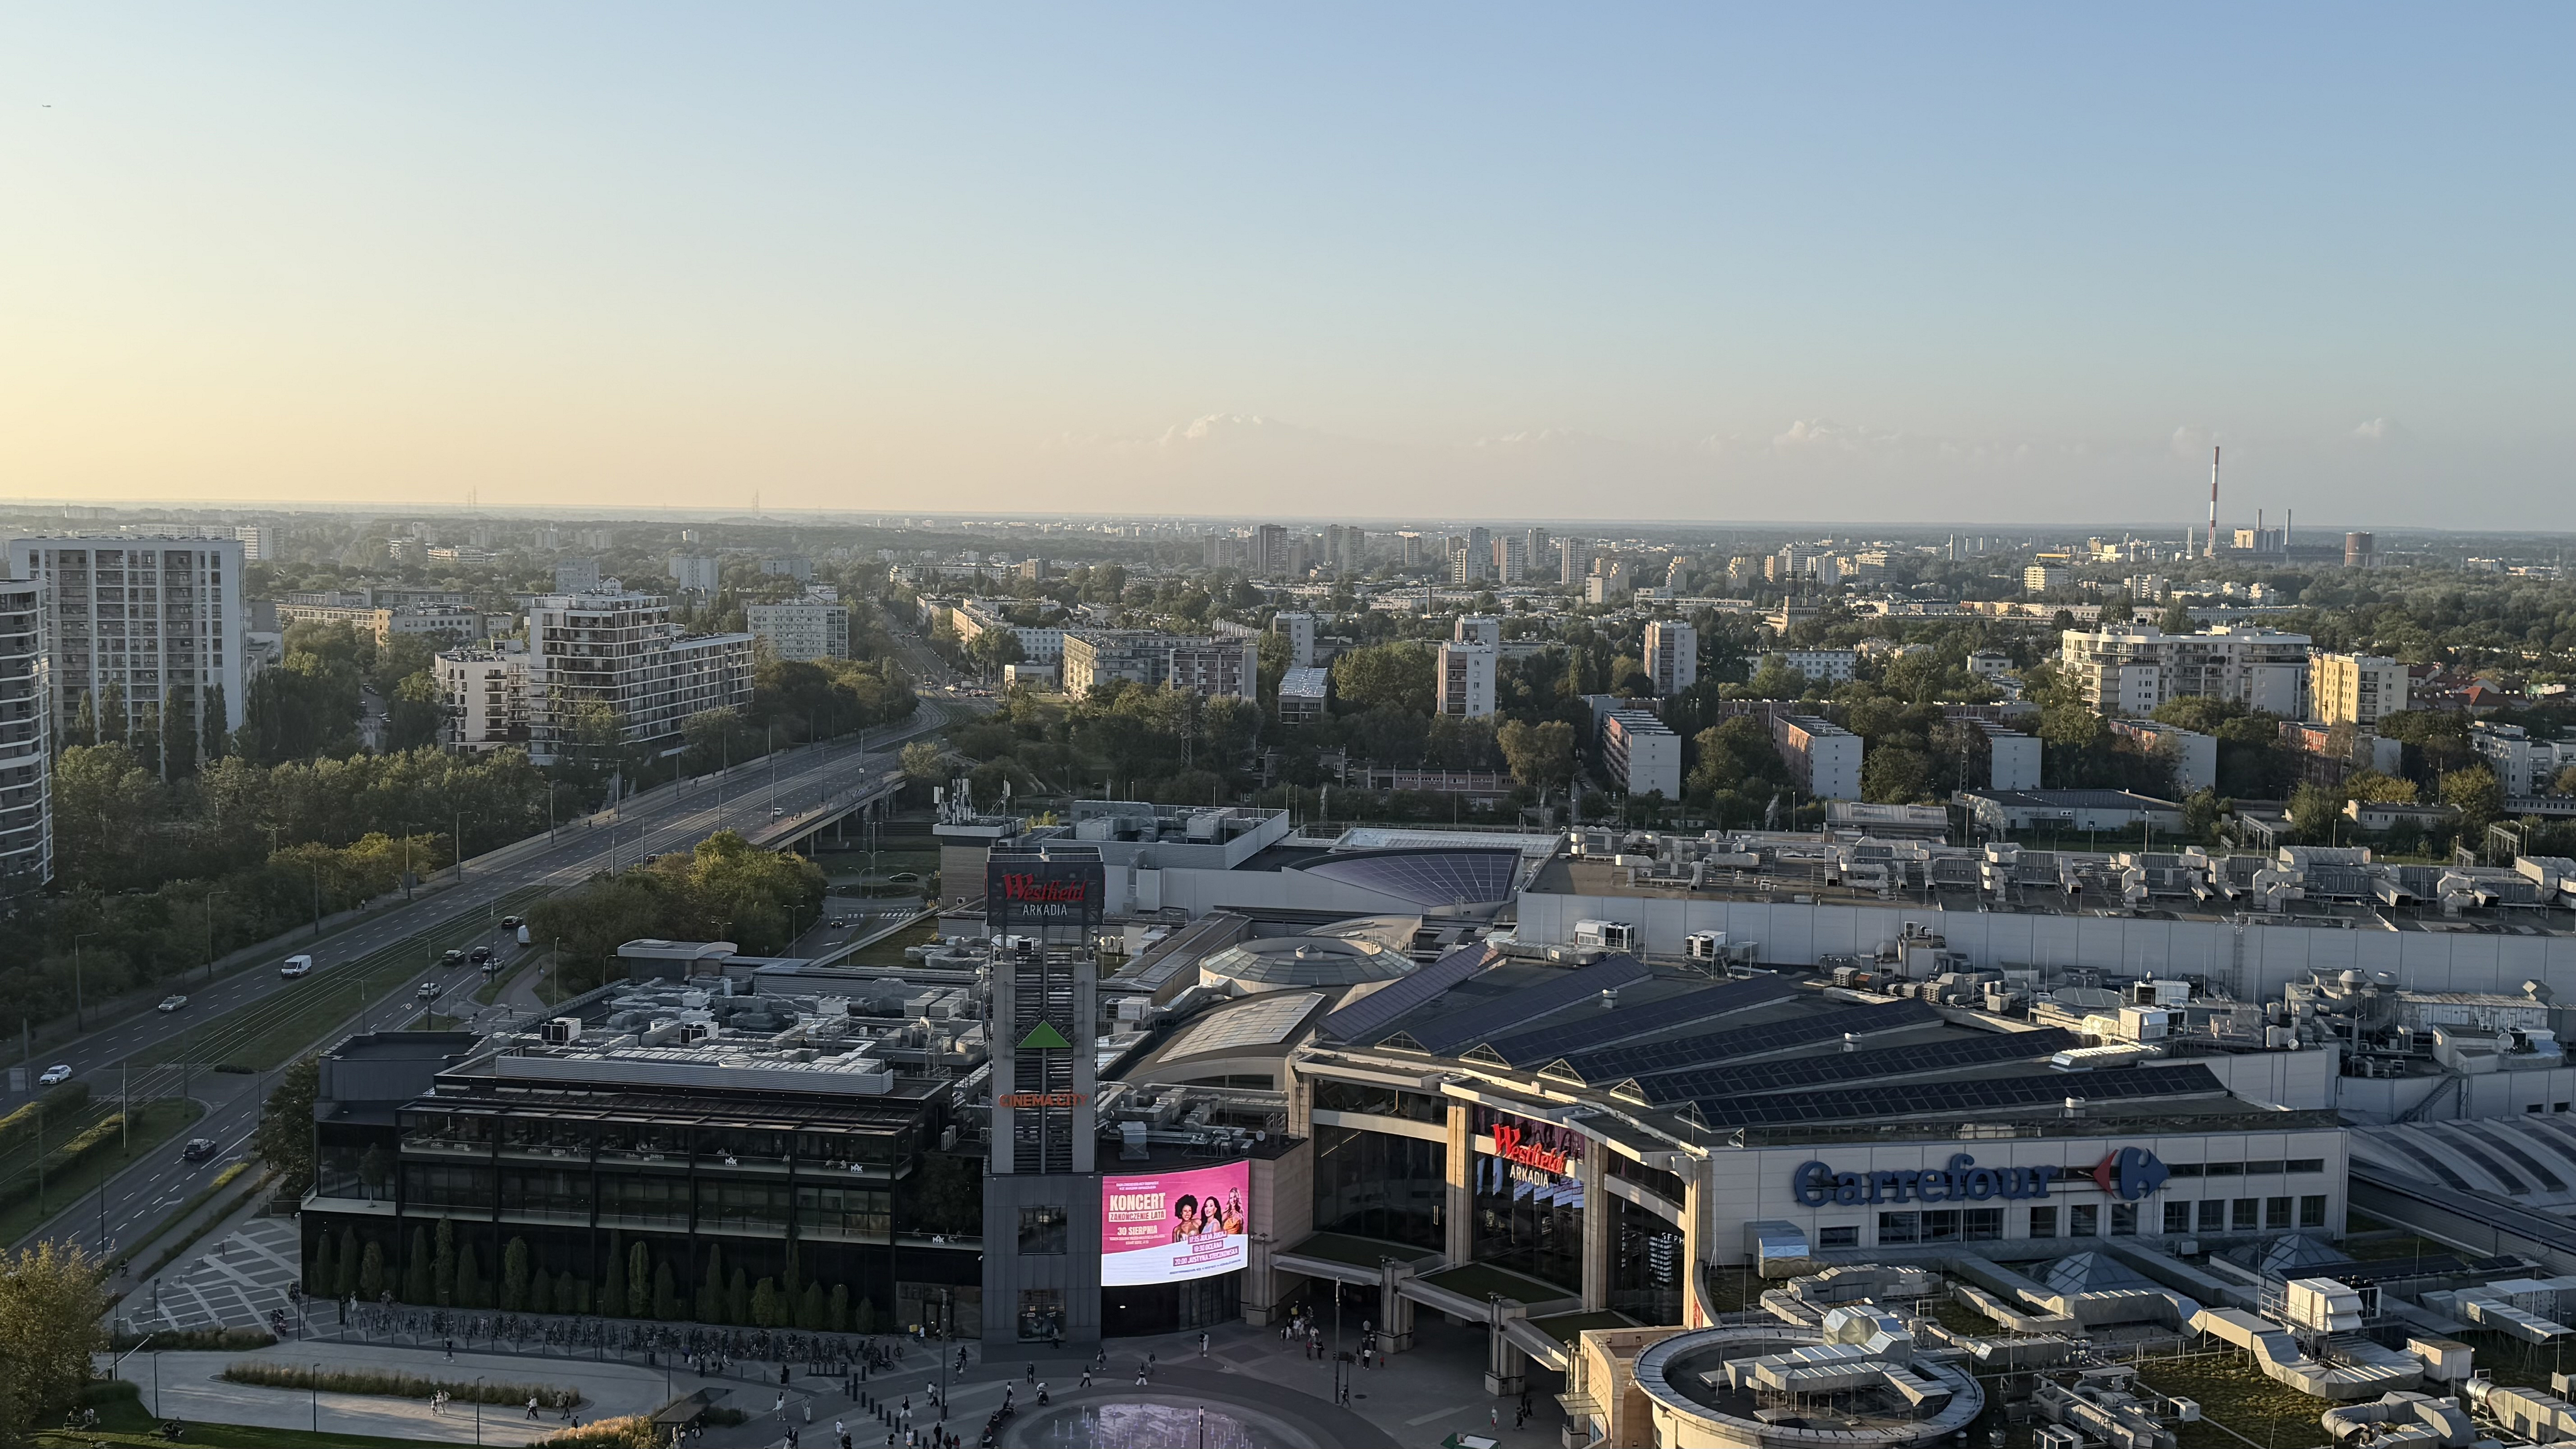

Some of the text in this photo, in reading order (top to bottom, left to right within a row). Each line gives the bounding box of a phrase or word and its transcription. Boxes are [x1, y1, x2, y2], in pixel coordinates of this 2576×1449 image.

[1001, 873, 1088, 901] Westfield
[1023, 904, 1067, 916] ARKADIA
[999, 1093, 1089, 1107] CINEMA CITY
[1491, 1123, 1568, 1175] Westfield
[1509, 1165, 1550, 1189] ARKADIA
[1794, 1153, 2058, 1208] Carrefour
[1109, 1192, 1166, 1211] KONCERT
[1151, 1211, 1165, 1219] LATA
[1117, 1224, 1158, 1236] 30 SIERPNIA
